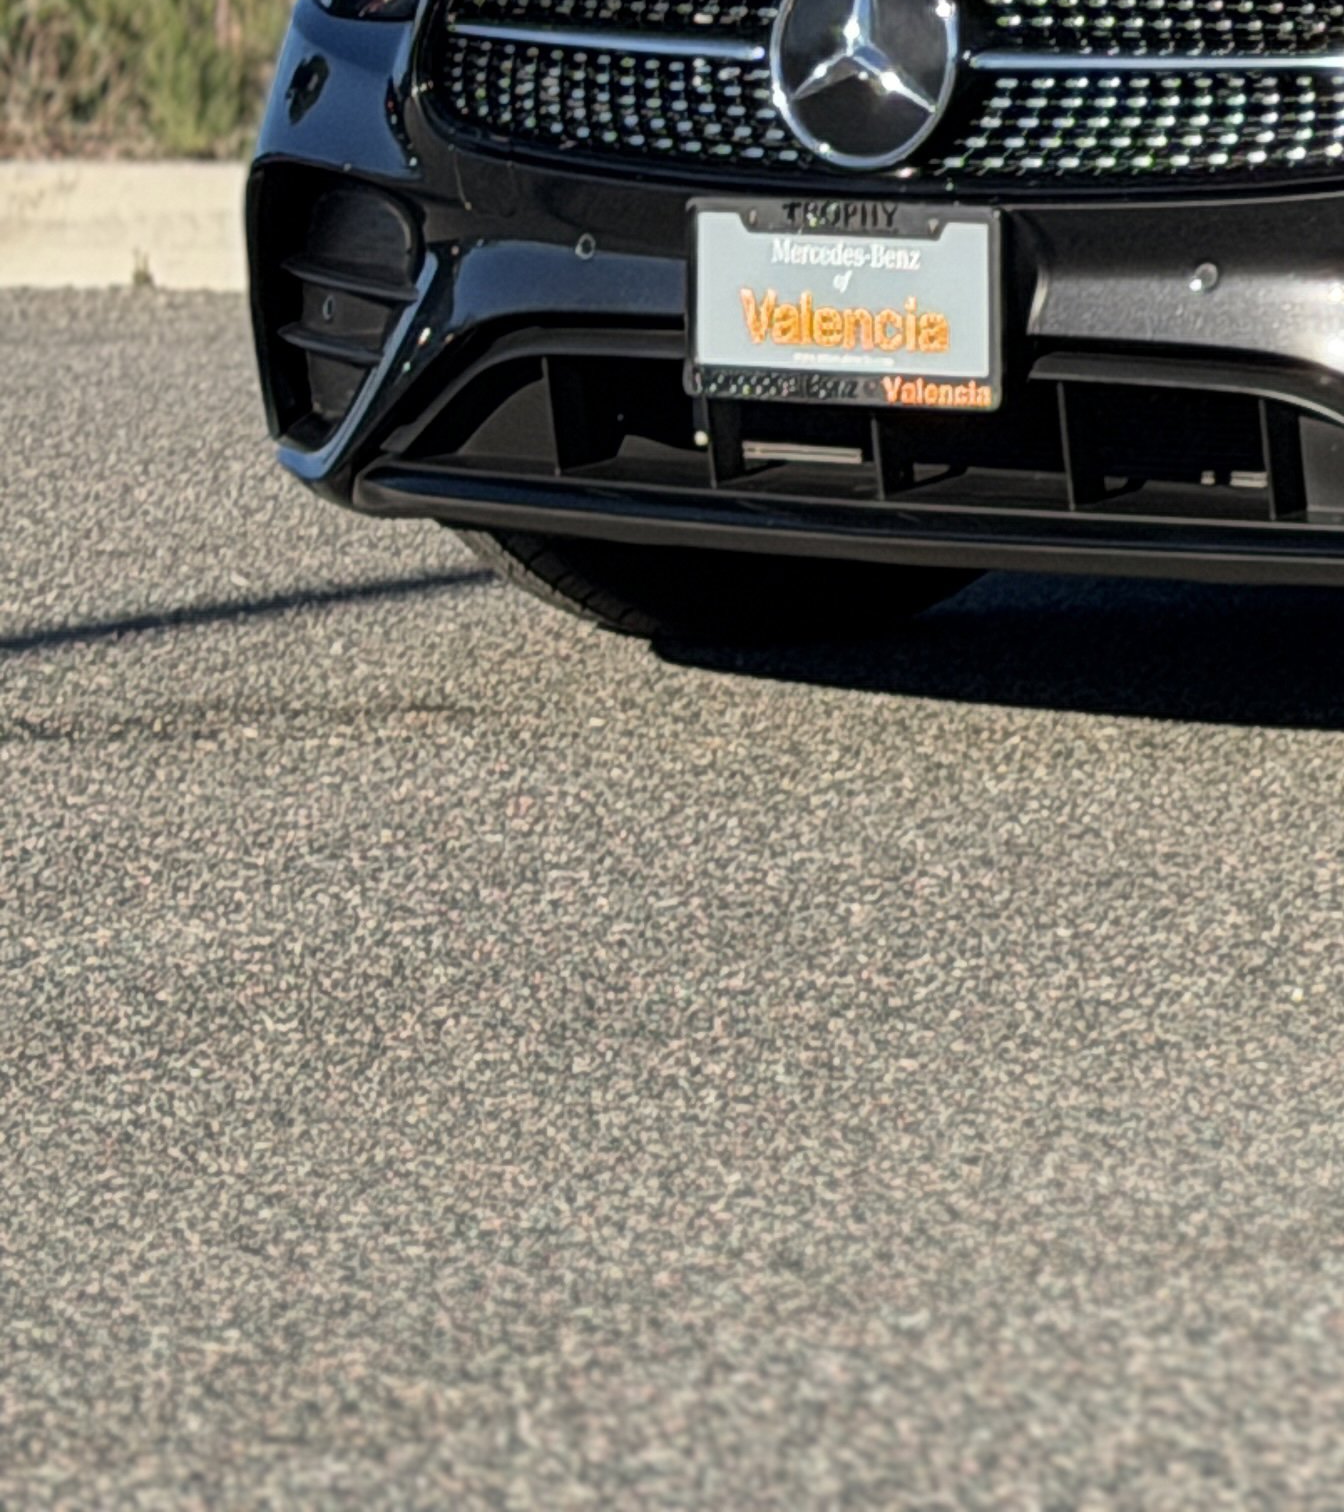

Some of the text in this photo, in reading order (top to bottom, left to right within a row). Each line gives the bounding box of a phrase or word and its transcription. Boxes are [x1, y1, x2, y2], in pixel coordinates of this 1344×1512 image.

[770, 237, 922, 271] Mercedes-Benz
[832, 270, 854, 294] of
[740, 288, 950, 352] Valencia
[881, 375, 993, 407] Valencia
